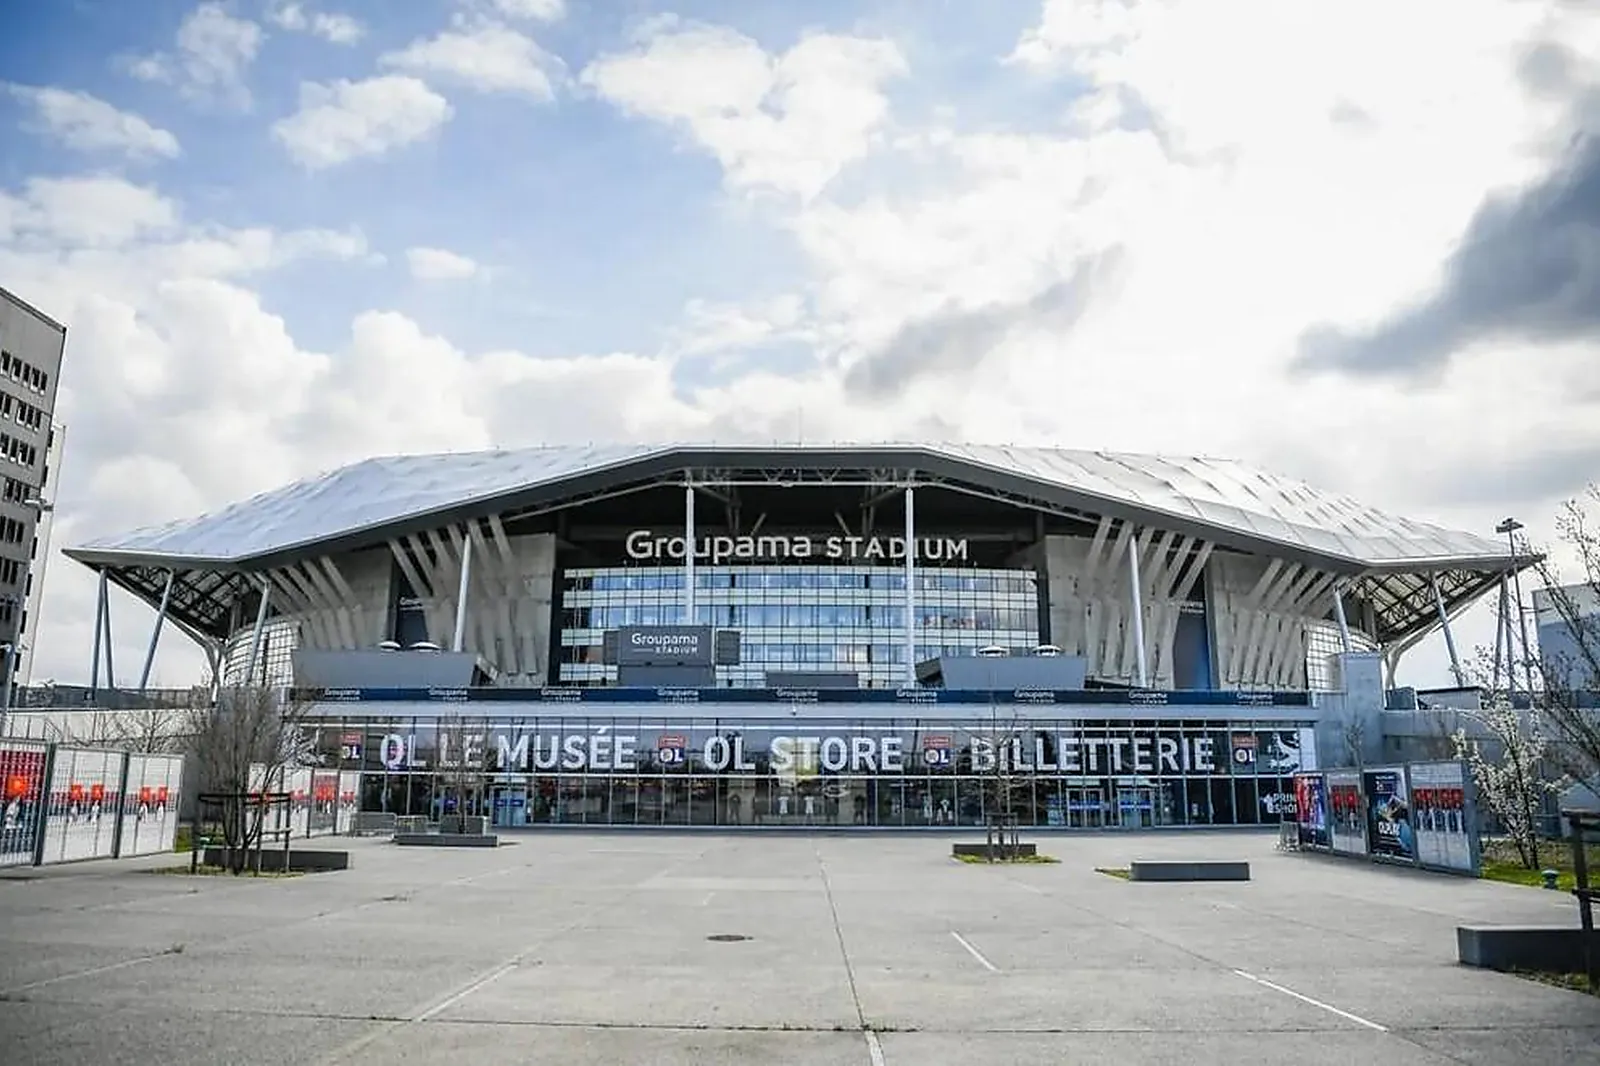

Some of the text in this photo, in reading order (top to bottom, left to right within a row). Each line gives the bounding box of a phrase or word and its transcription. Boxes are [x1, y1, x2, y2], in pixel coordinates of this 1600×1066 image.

[625, 529, 968, 564] Groupama STADIUM
[631, 632, 698, 646] Groupama
[655, 646, 698, 654] STADIUM
[380, 728, 638, 770] OL LE MUSÉE
[660, 747, 684, 762] OL
[703, 735, 905, 771] OL STORE
[924, 749, 950, 764] OL
[970, 736, 1216, 773] BILLETTERIE
[1235, 748, 1256, 762] OL
